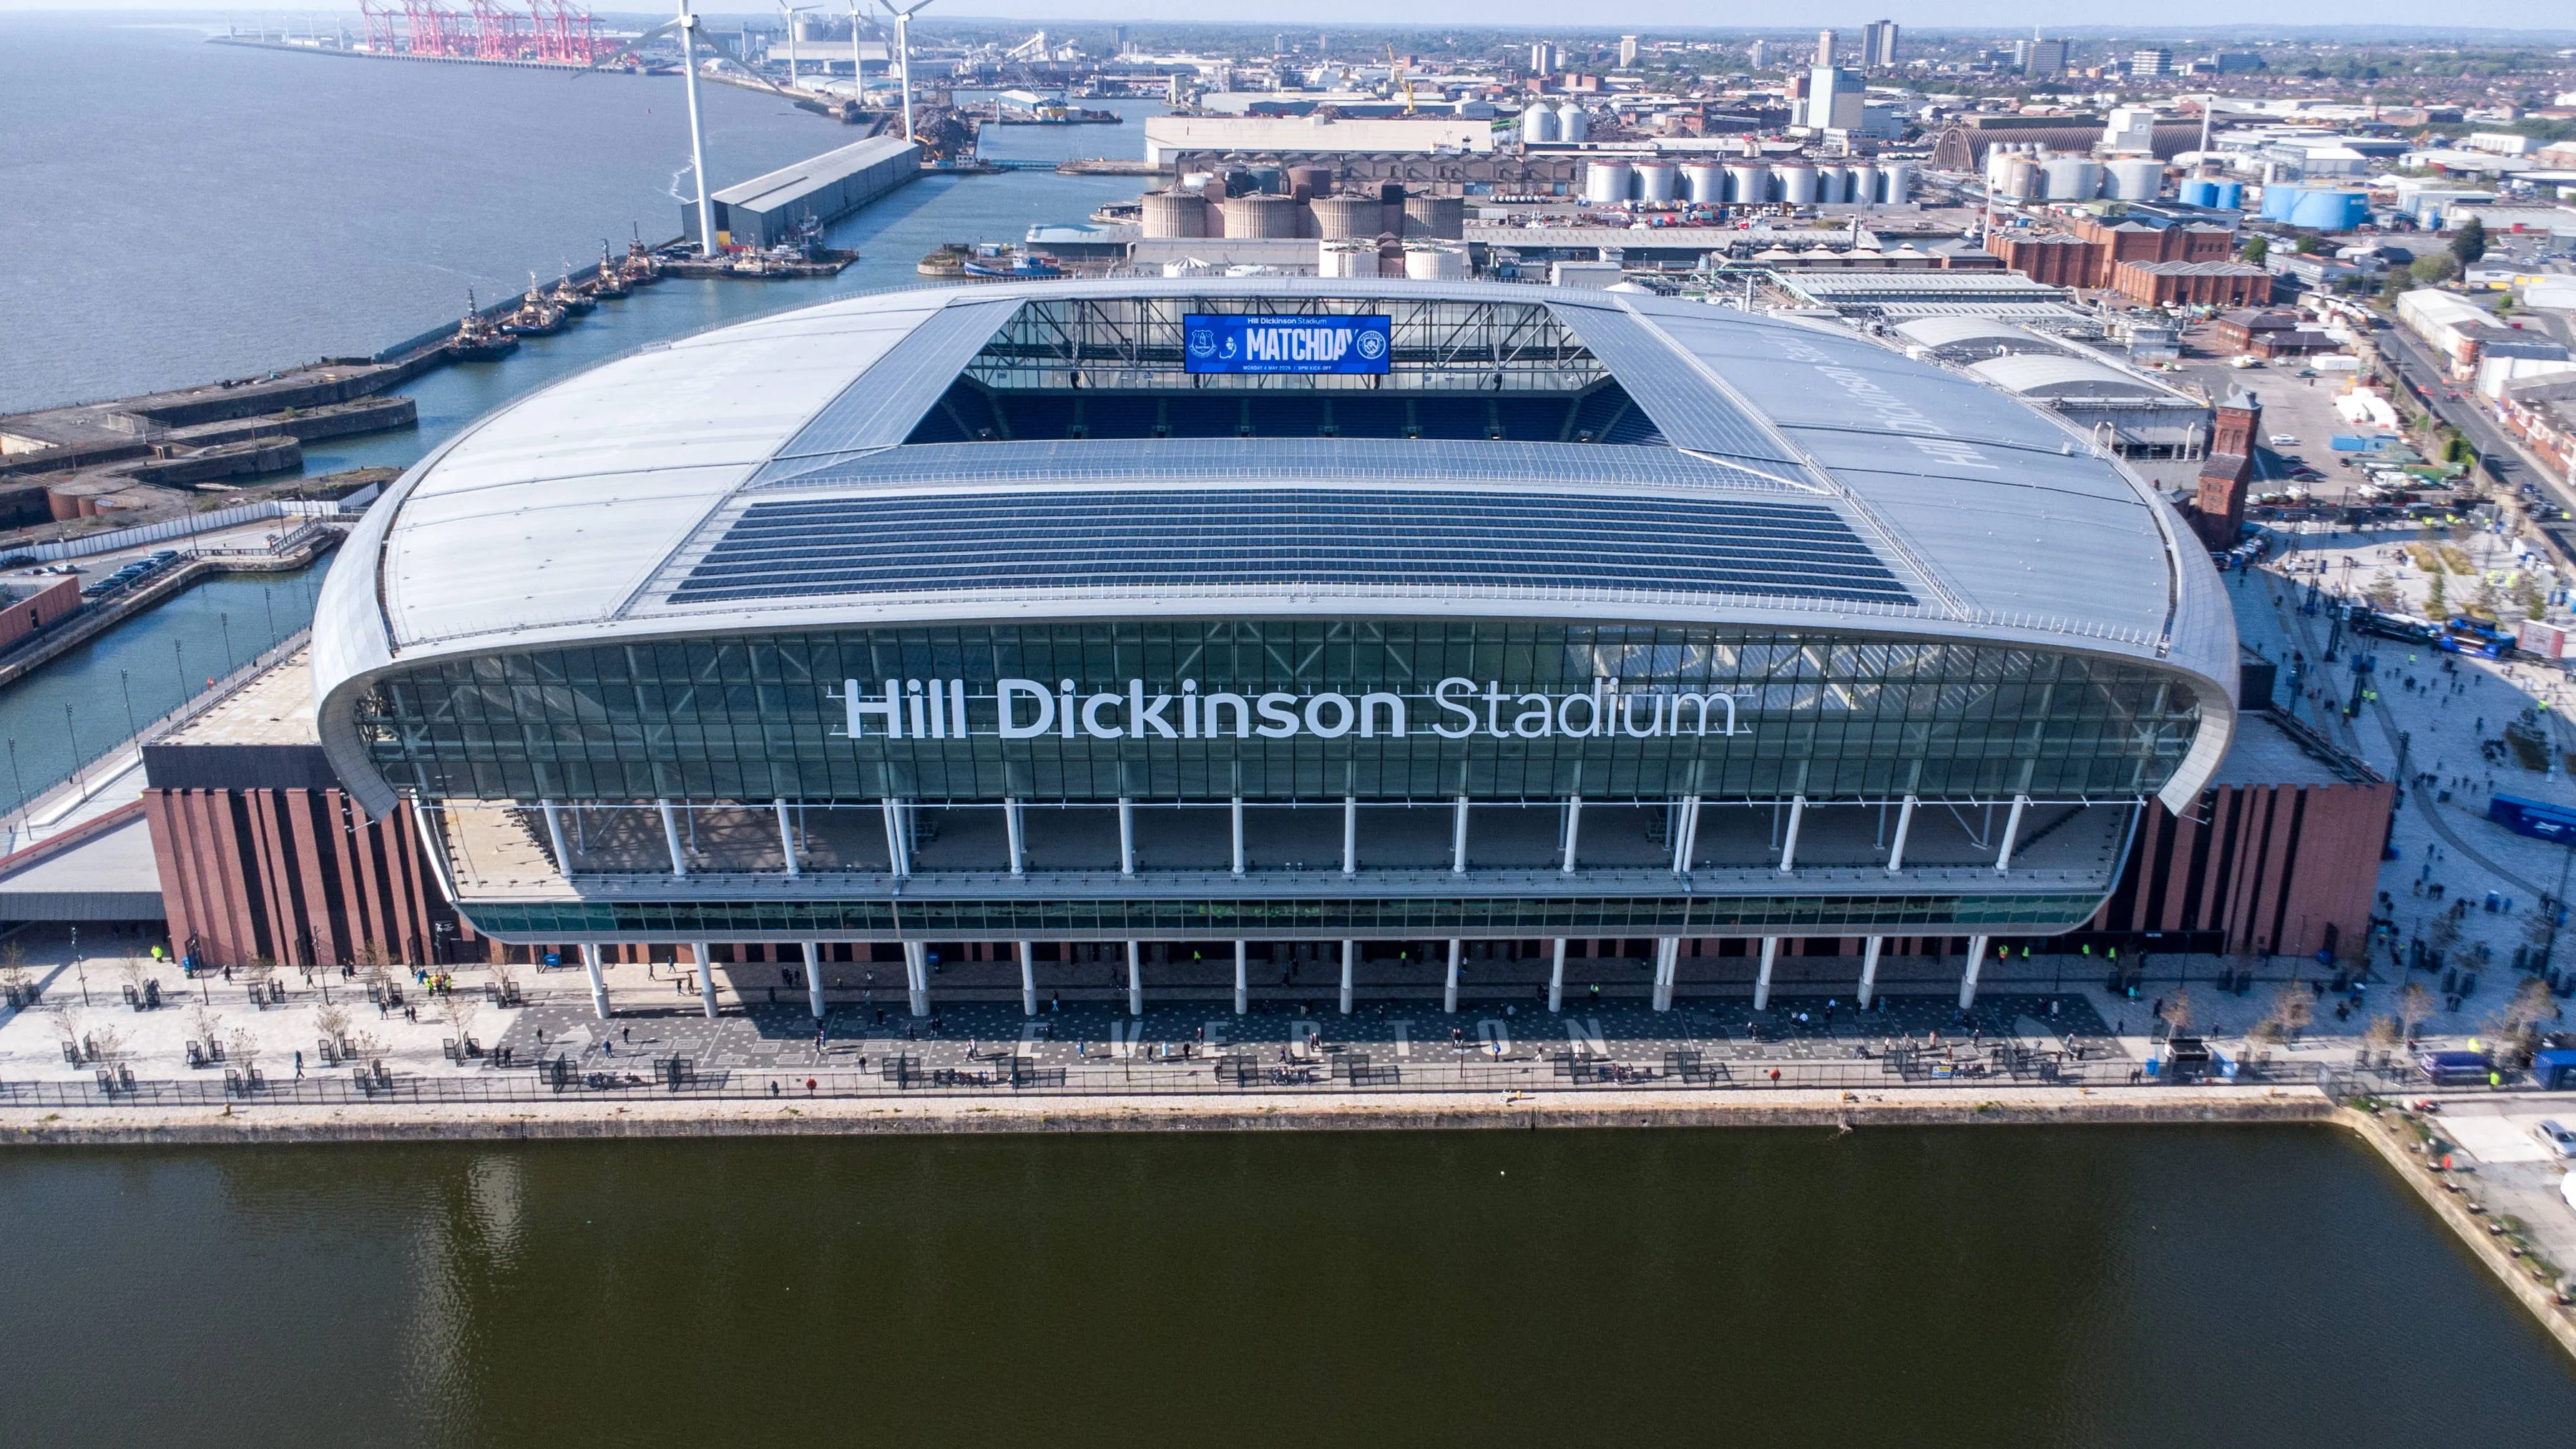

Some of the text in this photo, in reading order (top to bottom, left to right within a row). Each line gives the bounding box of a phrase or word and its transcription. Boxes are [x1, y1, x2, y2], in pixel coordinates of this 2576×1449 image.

[1246, 328, 1358, 360] MATCHDAY
[845, 677, 1735, 740] Hill Dickinson Stadium
[1017, 1018, 1608, 1058] EVERTON
